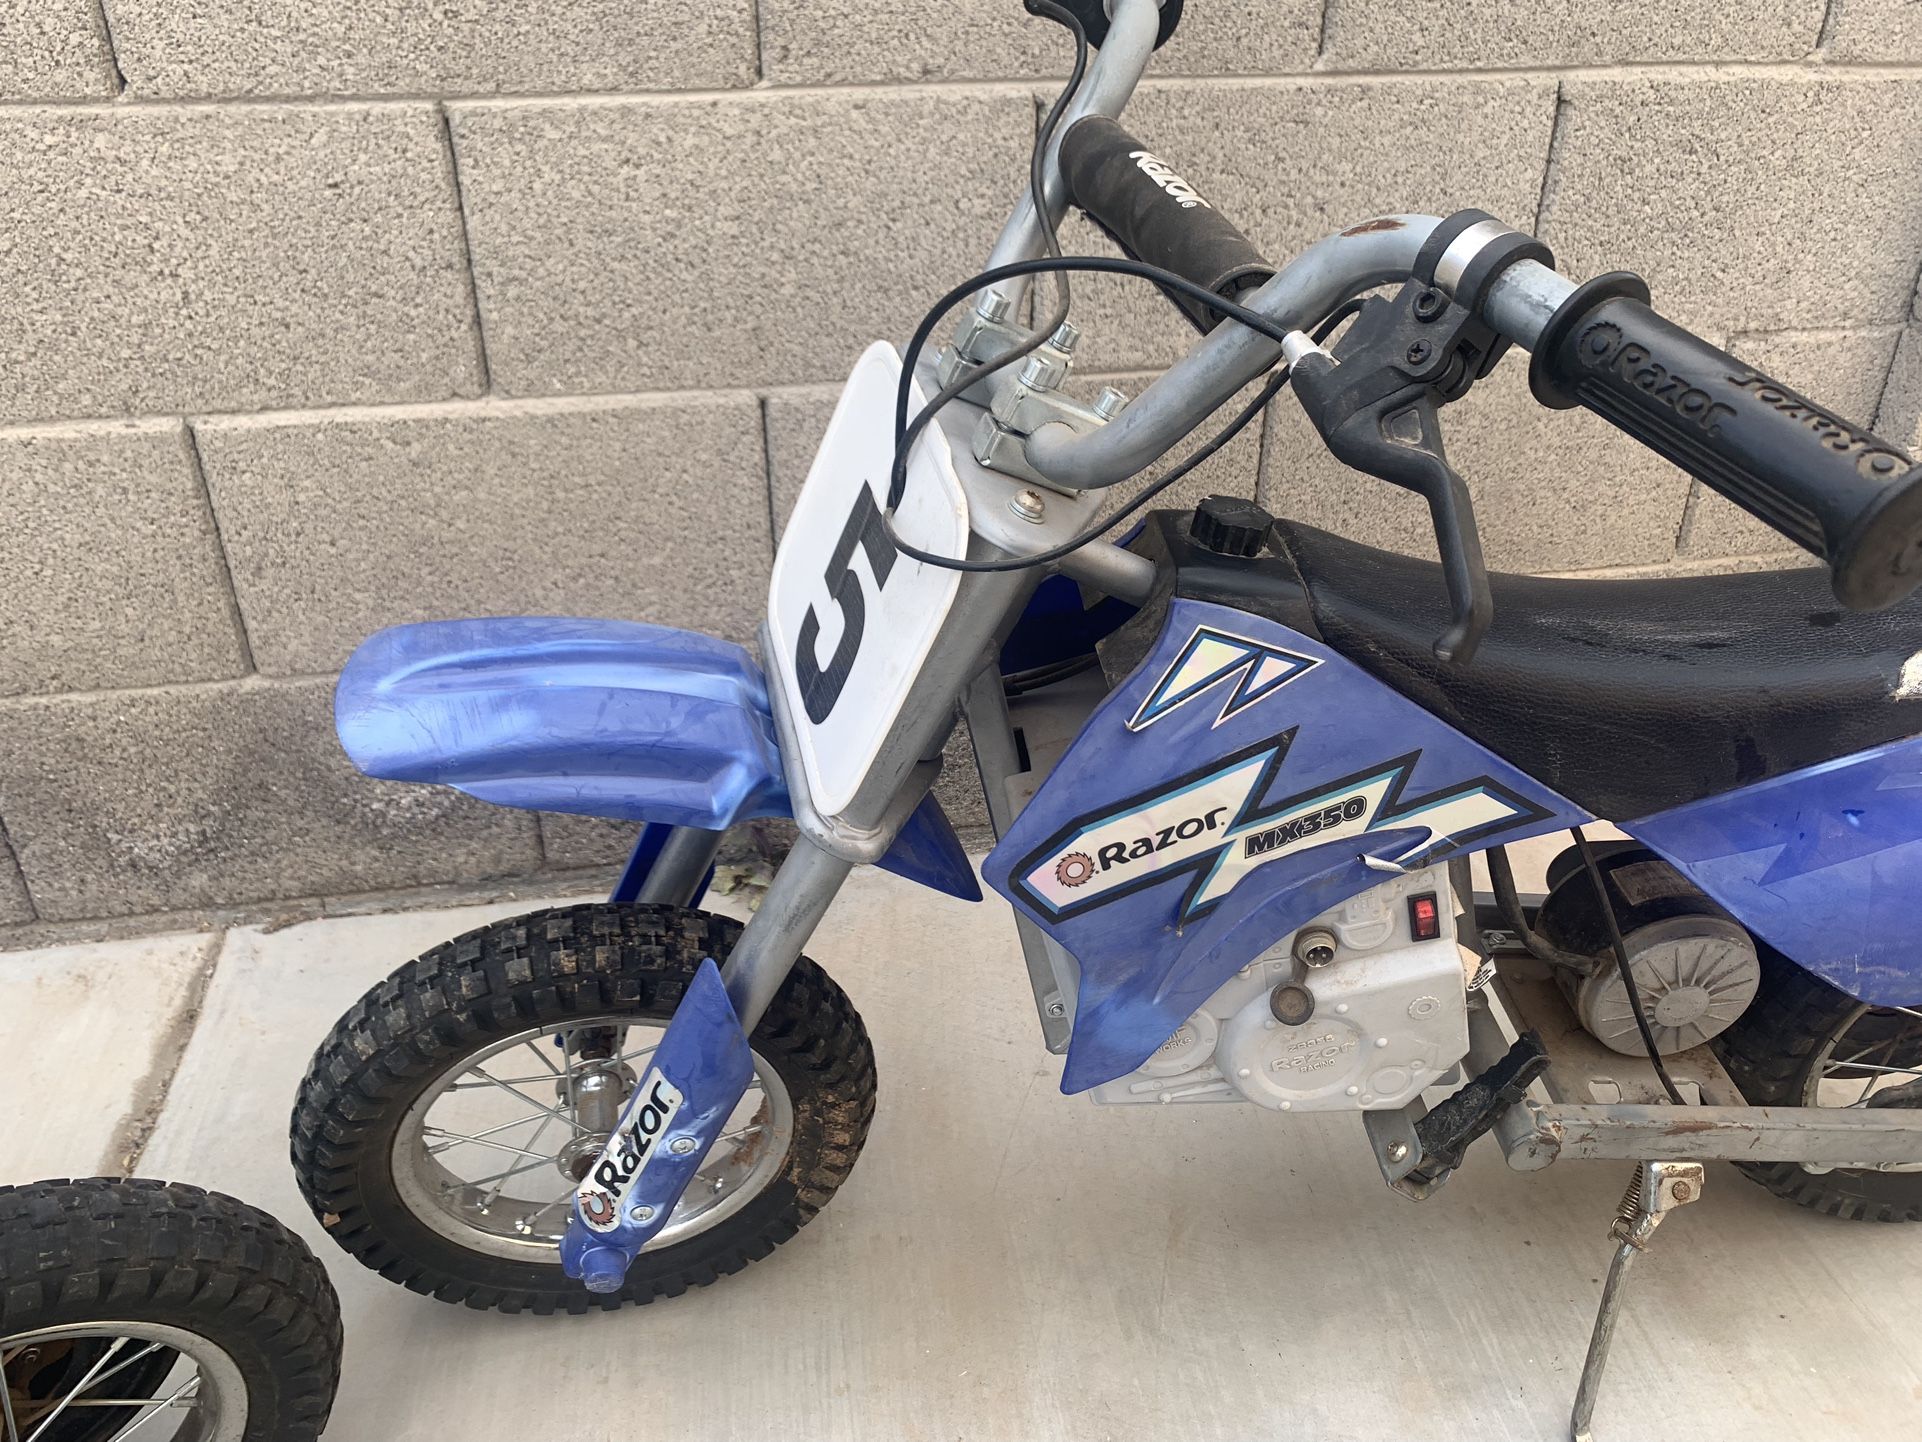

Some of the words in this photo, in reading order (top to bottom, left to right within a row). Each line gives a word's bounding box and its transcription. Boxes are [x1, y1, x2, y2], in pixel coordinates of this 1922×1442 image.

[1128, 151, 1211, 208] Razor
[1610, 342, 1737, 434] Razor
[796, 479, 898, 725] 5
[1097, 806, 1228, 872] Razor
[1244, 796, 1368, 859] MX350
[594, 1080, 670, 1198] Razor
